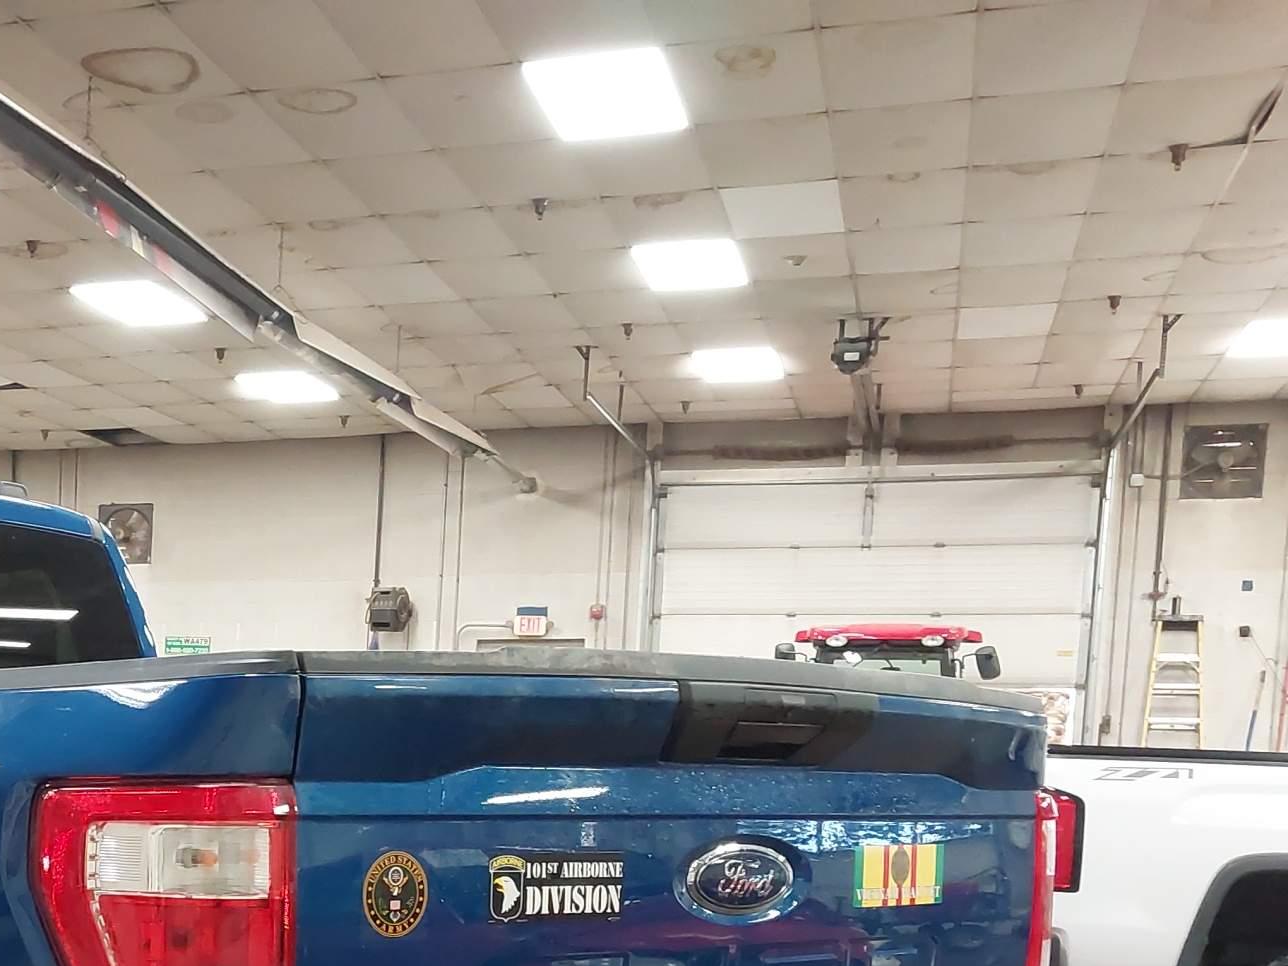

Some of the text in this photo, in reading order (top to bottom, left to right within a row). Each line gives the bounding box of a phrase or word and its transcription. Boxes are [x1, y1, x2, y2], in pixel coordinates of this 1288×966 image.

[519, 617, 541, 632] EXIT
[1092, 766, 1194, 781] Z71
[368, 855, 424, 883] UNITED STATES
[526, 861, 624, 878] 101ST AIRBORNE
[717, 859, 775, 897] Ford
[524, 884, 623, 915] DIVISION
[379, 922, 410, 934] ARMY
